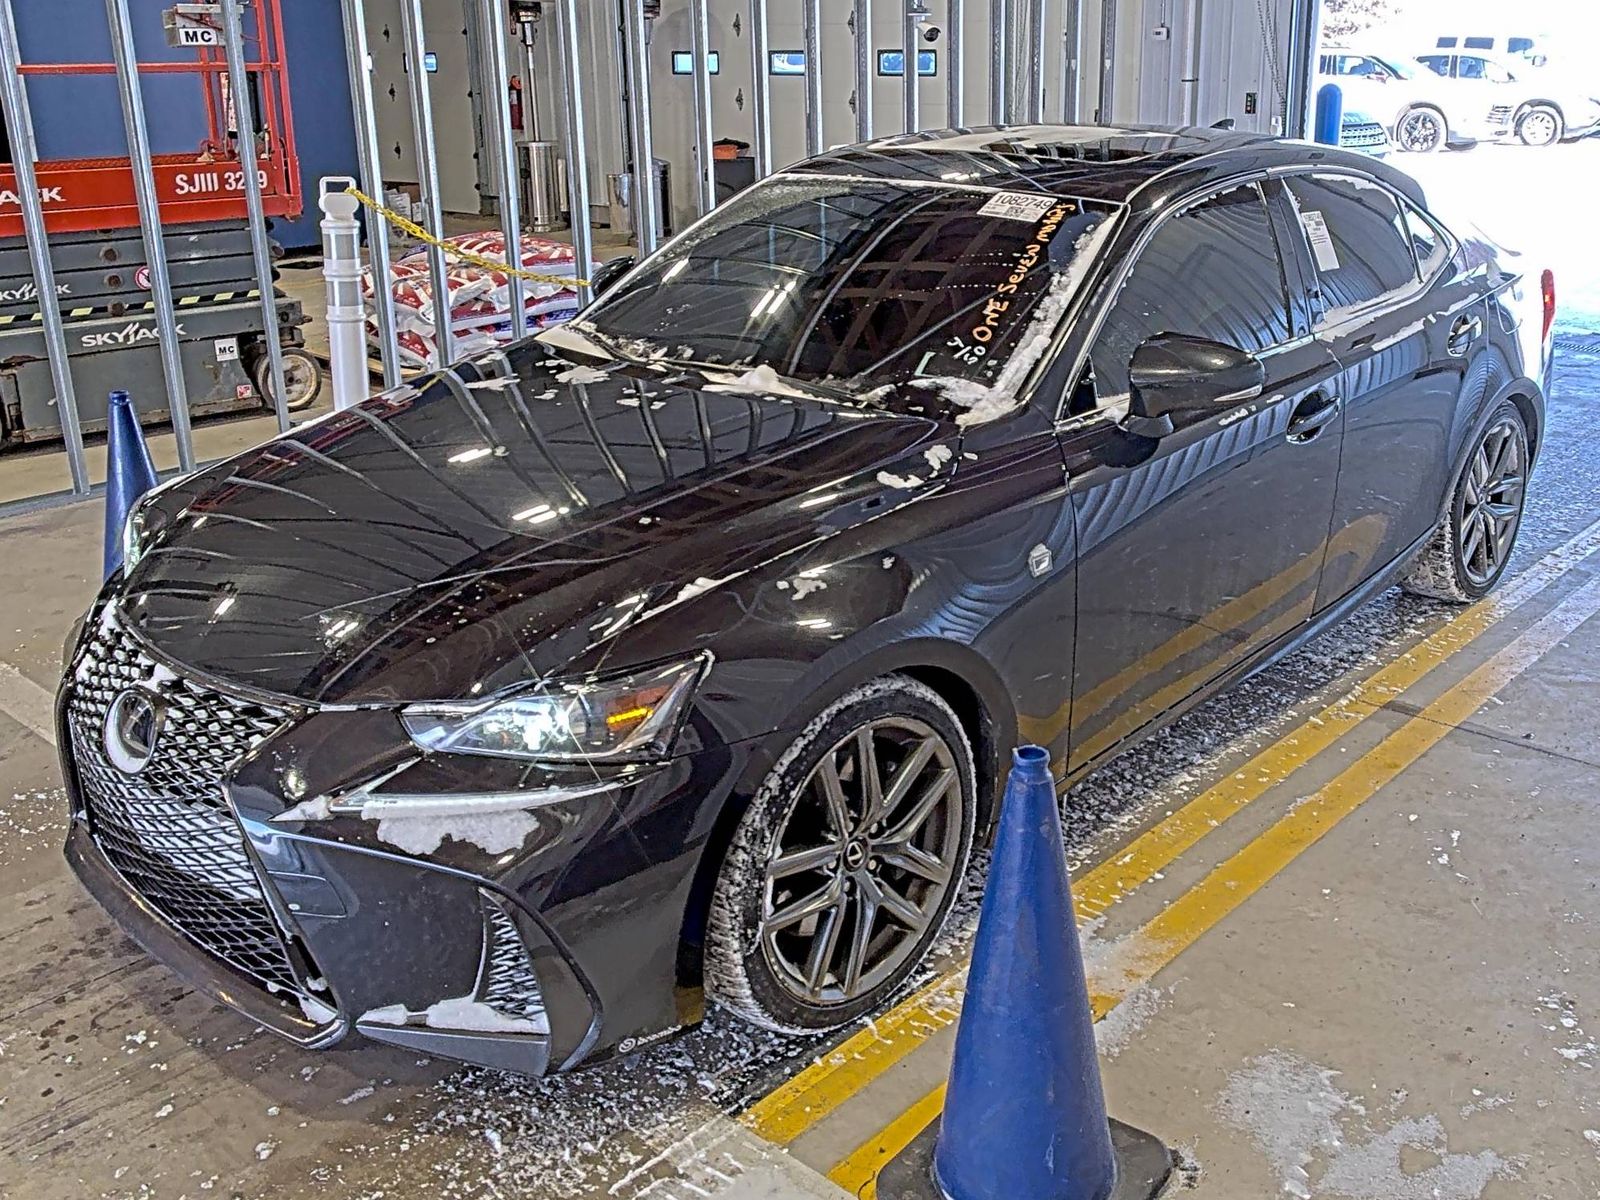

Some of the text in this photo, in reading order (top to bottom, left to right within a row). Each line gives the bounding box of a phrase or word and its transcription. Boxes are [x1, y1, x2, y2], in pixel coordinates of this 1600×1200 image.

[184, 31, 212, 43] MC
[175, 170, 268, 195] SJIII 329
[0, 187, 67, 205] AK
[994, 194, 1053, 210] 1082749
[218, 346, 235, 355] MC
